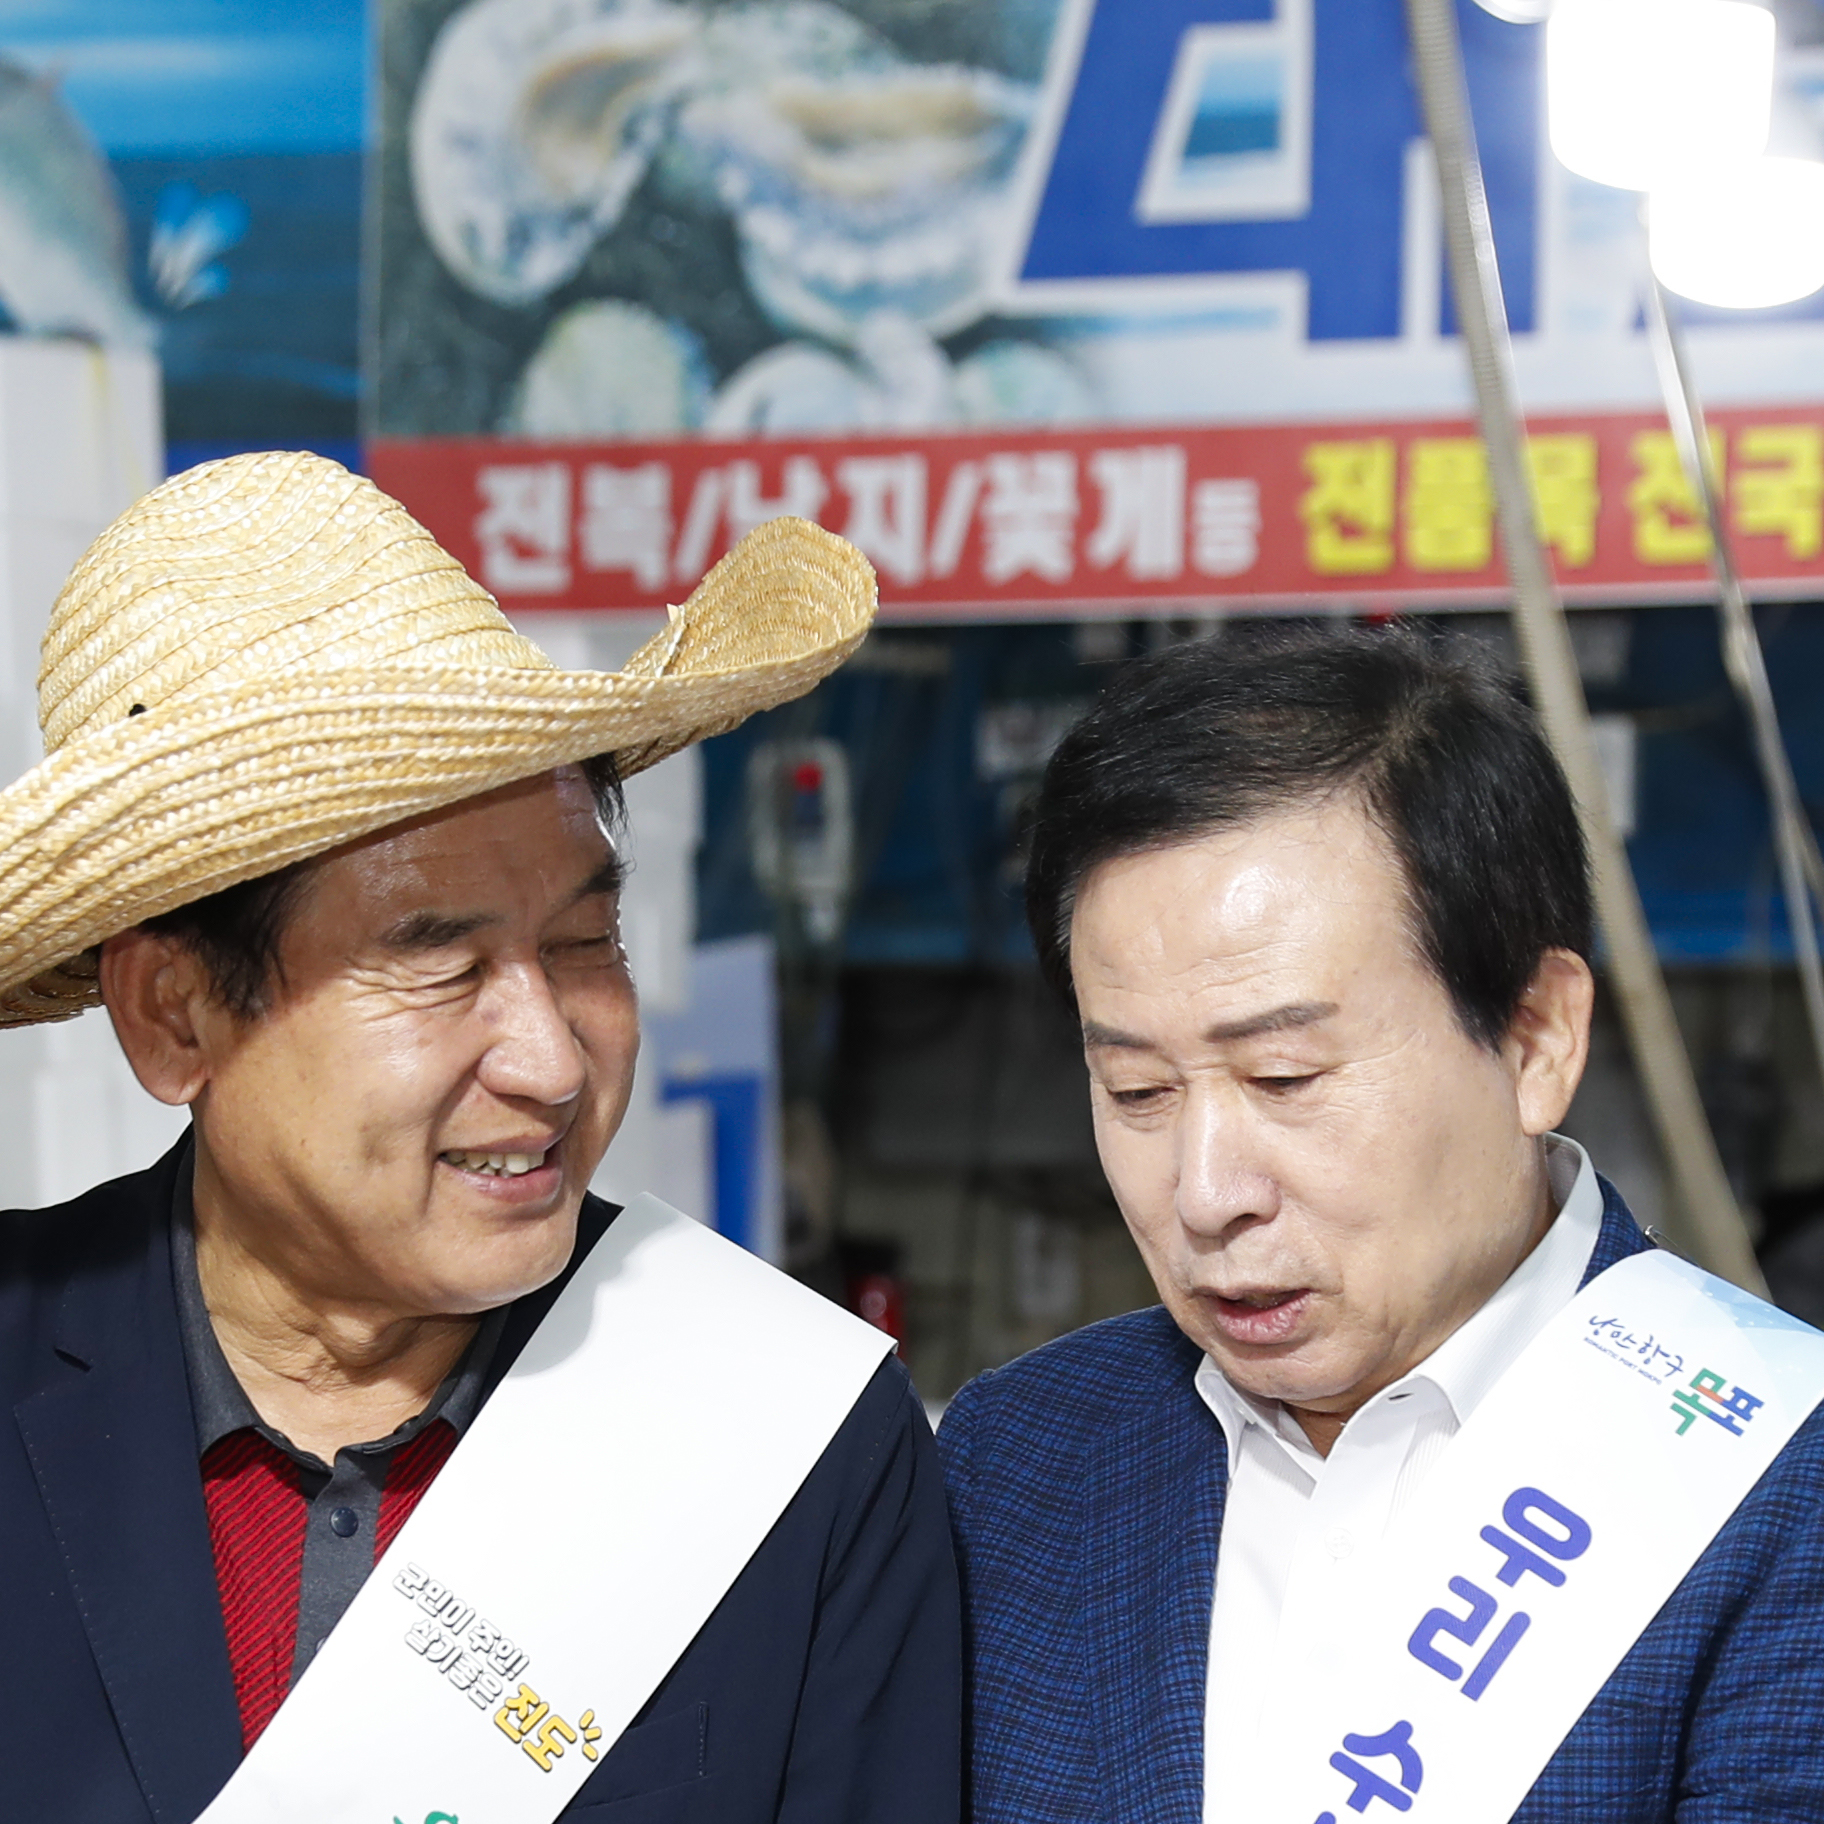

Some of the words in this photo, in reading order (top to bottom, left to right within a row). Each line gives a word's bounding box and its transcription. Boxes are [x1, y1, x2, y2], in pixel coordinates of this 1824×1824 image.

[1300, 434, 1600, 577] 전품목
[1670, 1367, 1765, 1437] 목포
[393, 1562, 476, 1635] 군민이
[468, 1619, 531, 1682] 주인!
[1407, 1487, 1592, 1701] 우리
[493, 1683, 578, 1774] 진도
